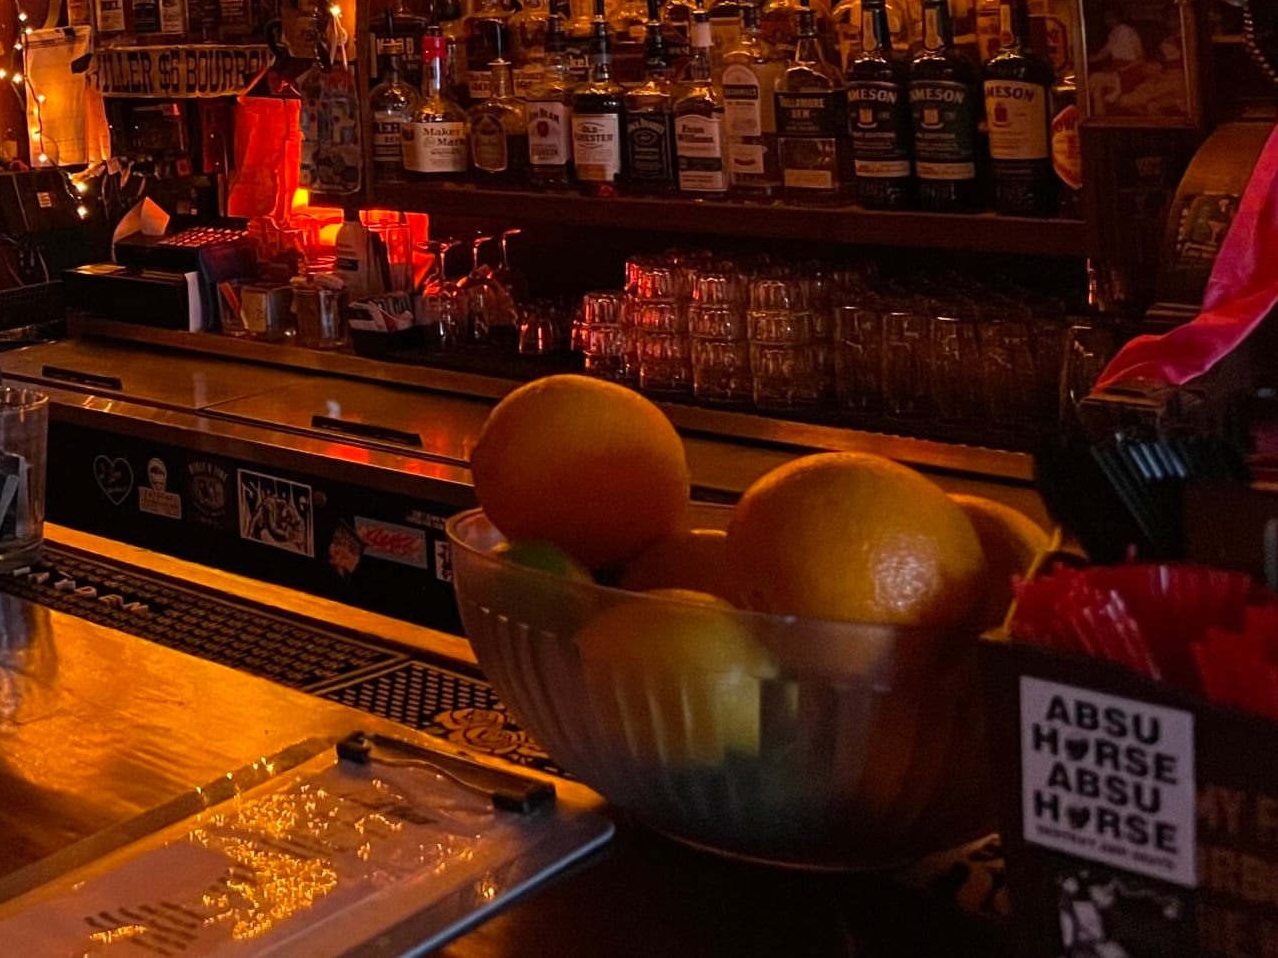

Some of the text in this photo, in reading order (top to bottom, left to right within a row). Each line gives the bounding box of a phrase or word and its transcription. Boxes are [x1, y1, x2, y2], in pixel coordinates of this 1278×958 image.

[848, 88, 898, 104] AMESON
[910, 88, 965, 104] AMESON
[436, 137, 466, 147] Mark
[1045, 695, 1161, 745] ABSU
[1048, 761, 1161, 814] ABSU
